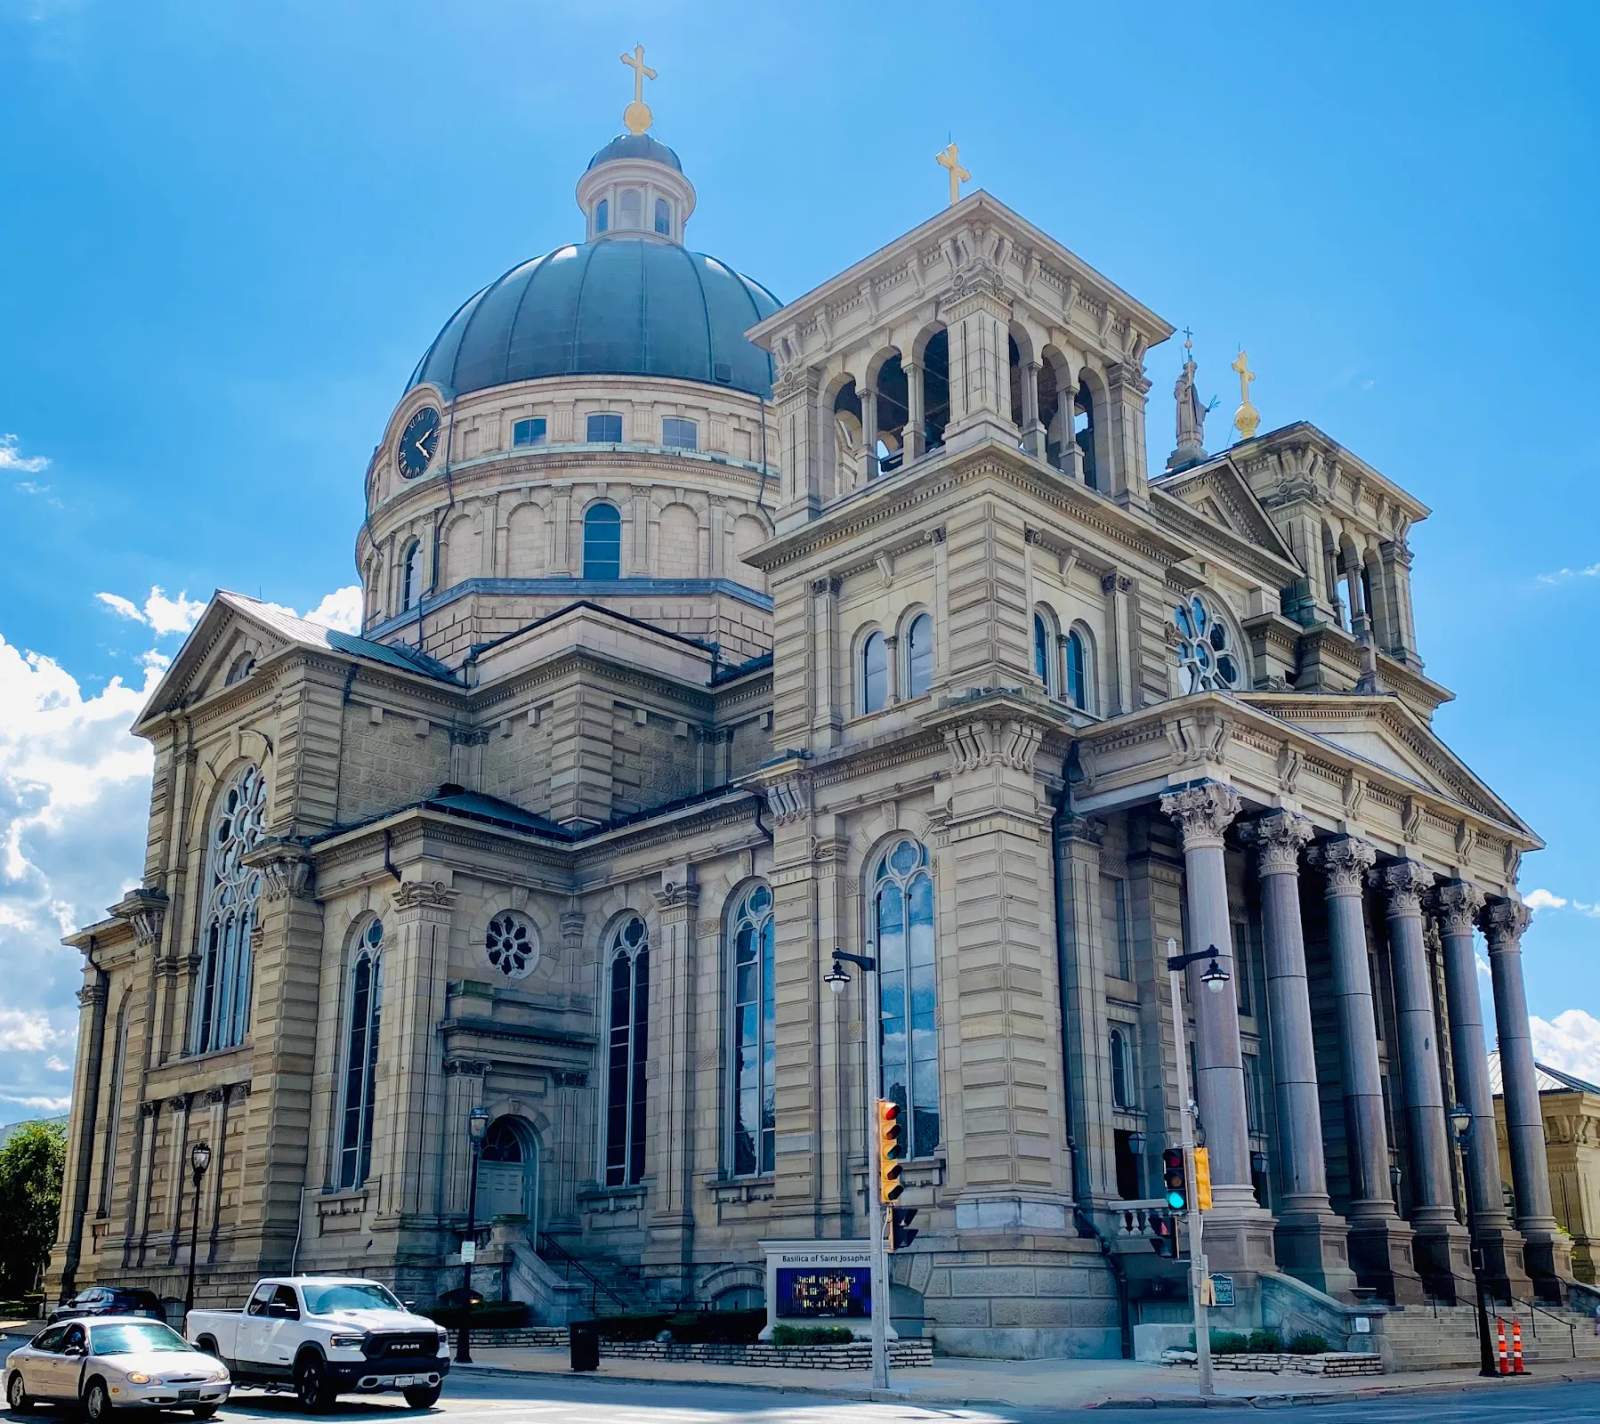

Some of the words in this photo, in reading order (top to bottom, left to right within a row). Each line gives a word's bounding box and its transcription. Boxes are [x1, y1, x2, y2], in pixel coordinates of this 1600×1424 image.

[782, 1255, 809, 1263] Basilica
[820, 1254, 838, 1262] Saint
[840, 1255, 871, 1263] Josaphat
